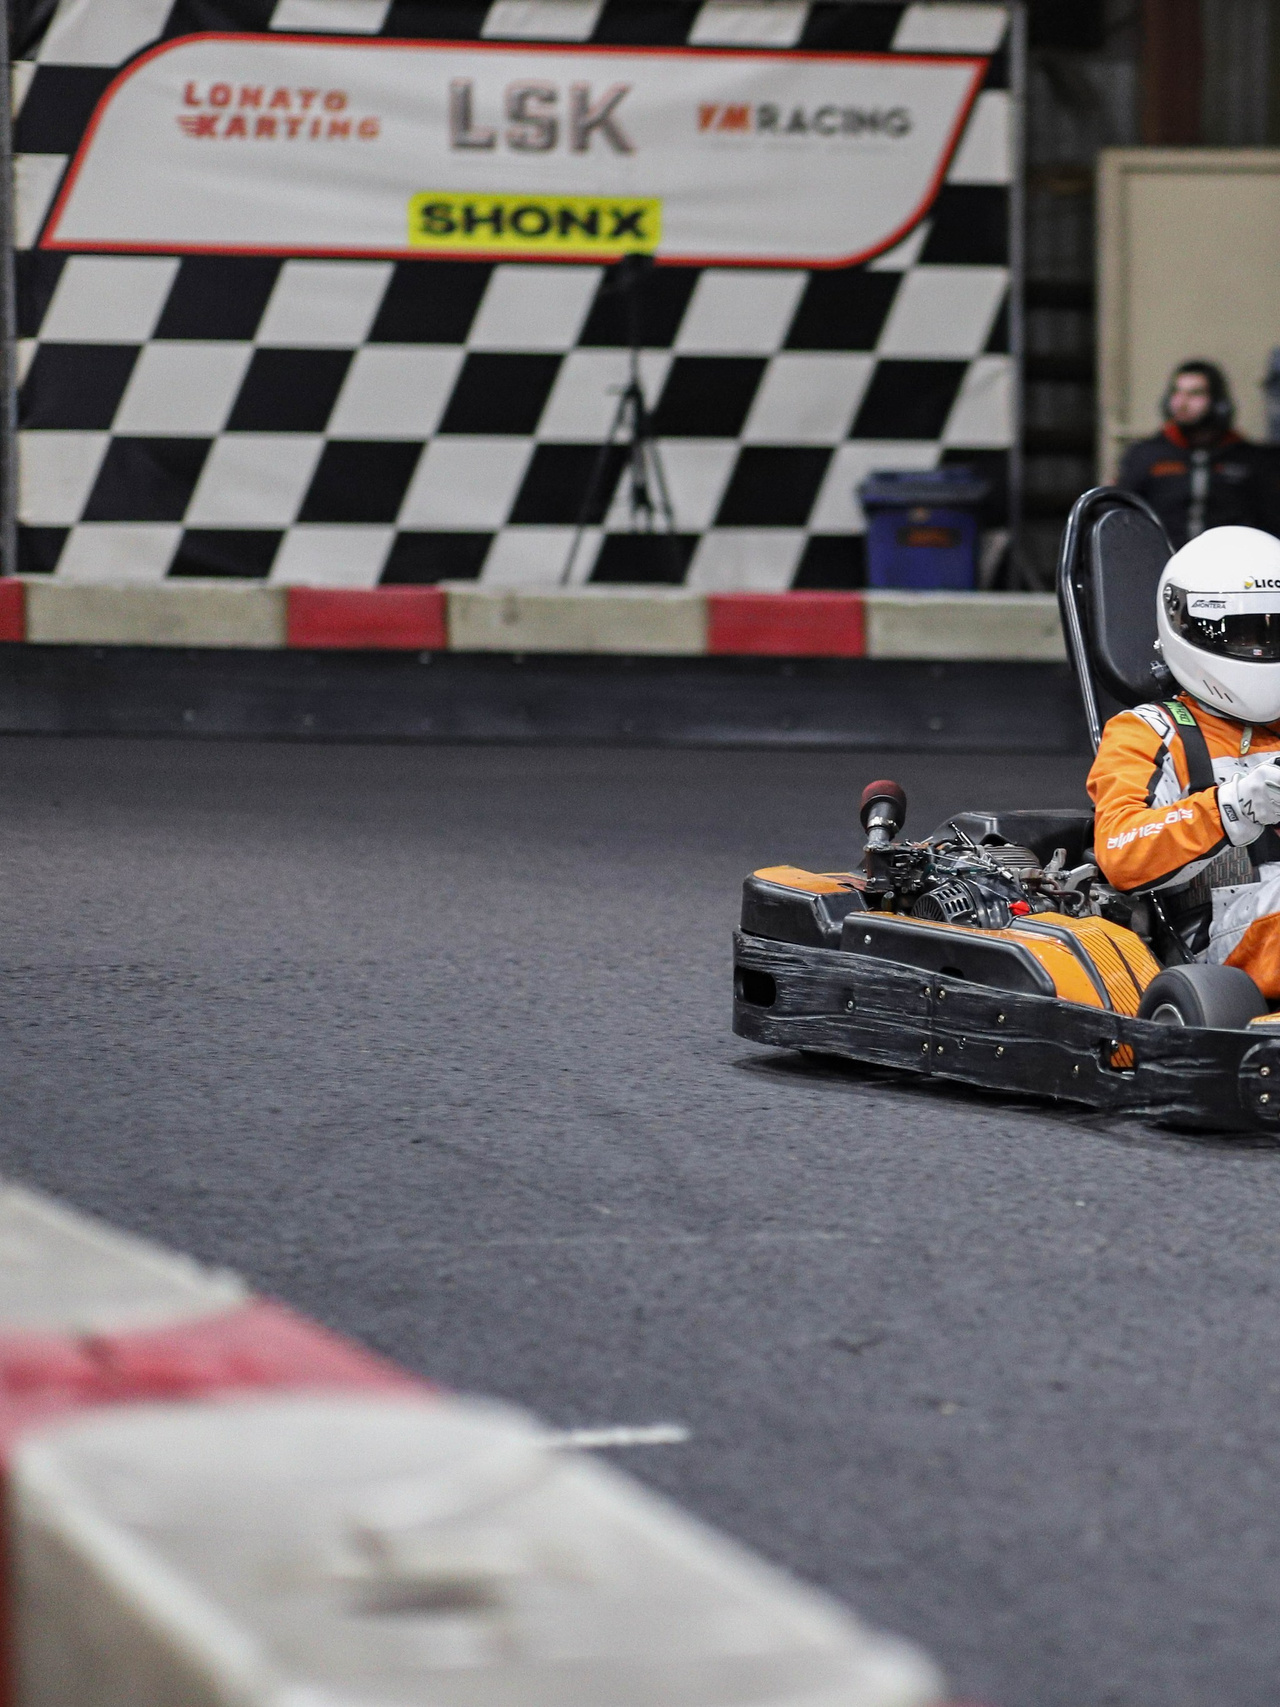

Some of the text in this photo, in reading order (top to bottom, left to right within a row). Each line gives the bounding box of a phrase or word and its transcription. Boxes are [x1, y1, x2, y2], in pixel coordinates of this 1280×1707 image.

[184, 82, 348, 112] LONATO
[192, 114, 380, 141] KARTING
[449, 78, 634, 155] LSK
[420, 202, 647, 241] SHONX
